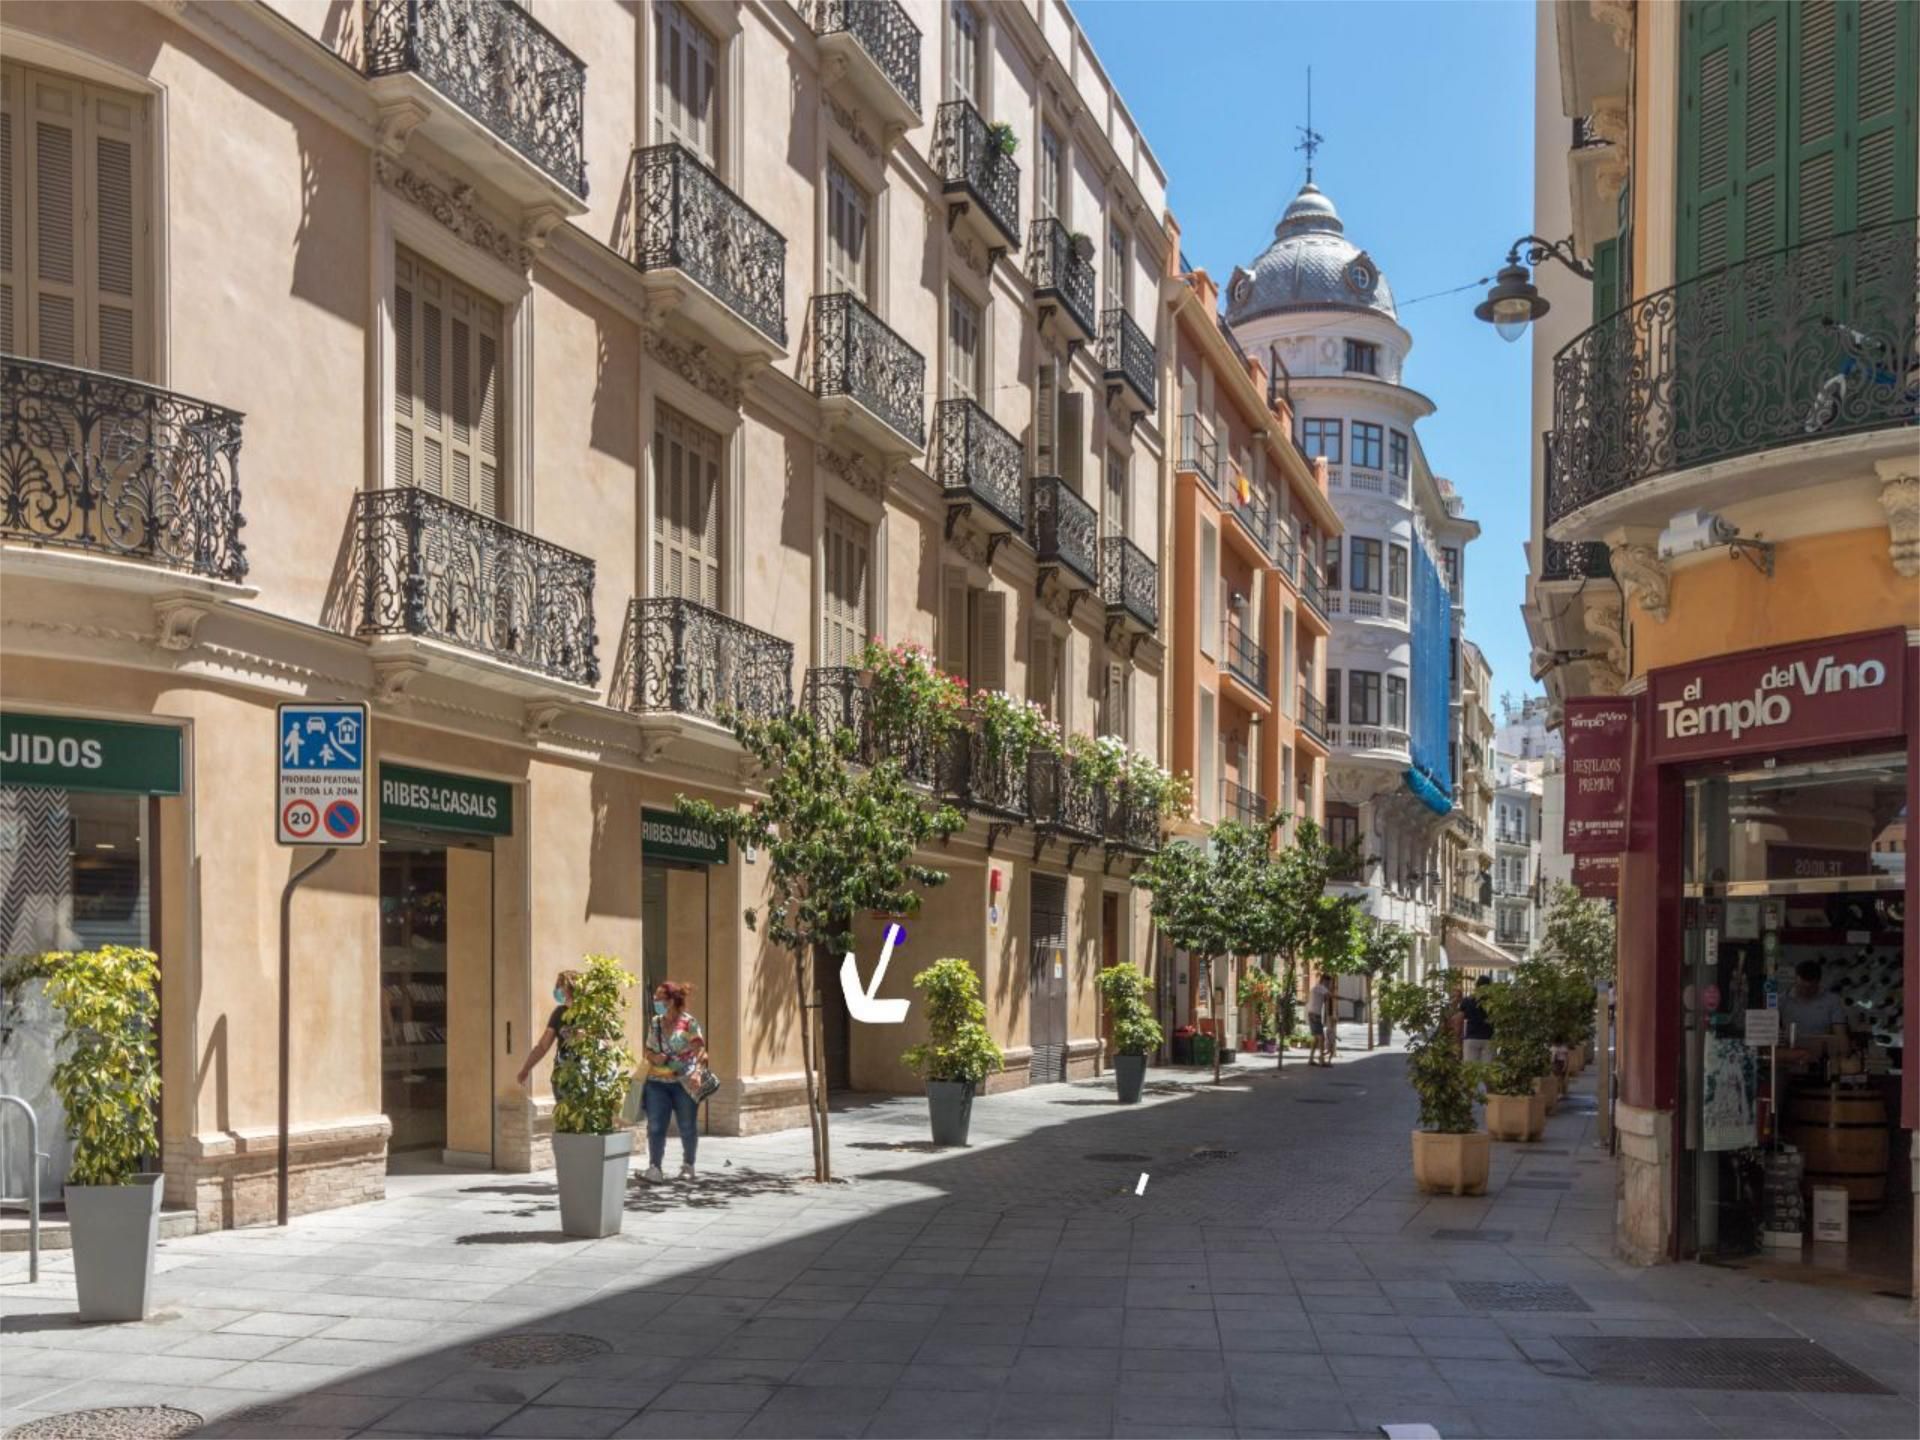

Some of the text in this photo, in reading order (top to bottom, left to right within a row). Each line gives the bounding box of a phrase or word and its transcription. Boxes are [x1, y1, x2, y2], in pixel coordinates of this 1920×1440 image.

[1683, 677, 1702, 701] el
[1761, 656, 1887, 696] del Vino
[1658, 688, 1792, 740] Templo
[0, 732, 103, 769] JIDOS
[1572, 758, 1622, 775] DESTILADOS
[281, 775, 362, 785] PRIORIDAD PEATONAL
[285, 787, 359, 796] EN TODA LA ZONA
[383, 780, 431, 810] RIBES
[440, 788, 498, 819] CASALS
[290, 812, 312, 825] 20
[642, 822, 674, 845] RIBES
[679, 827, 718, 851] CASALS
